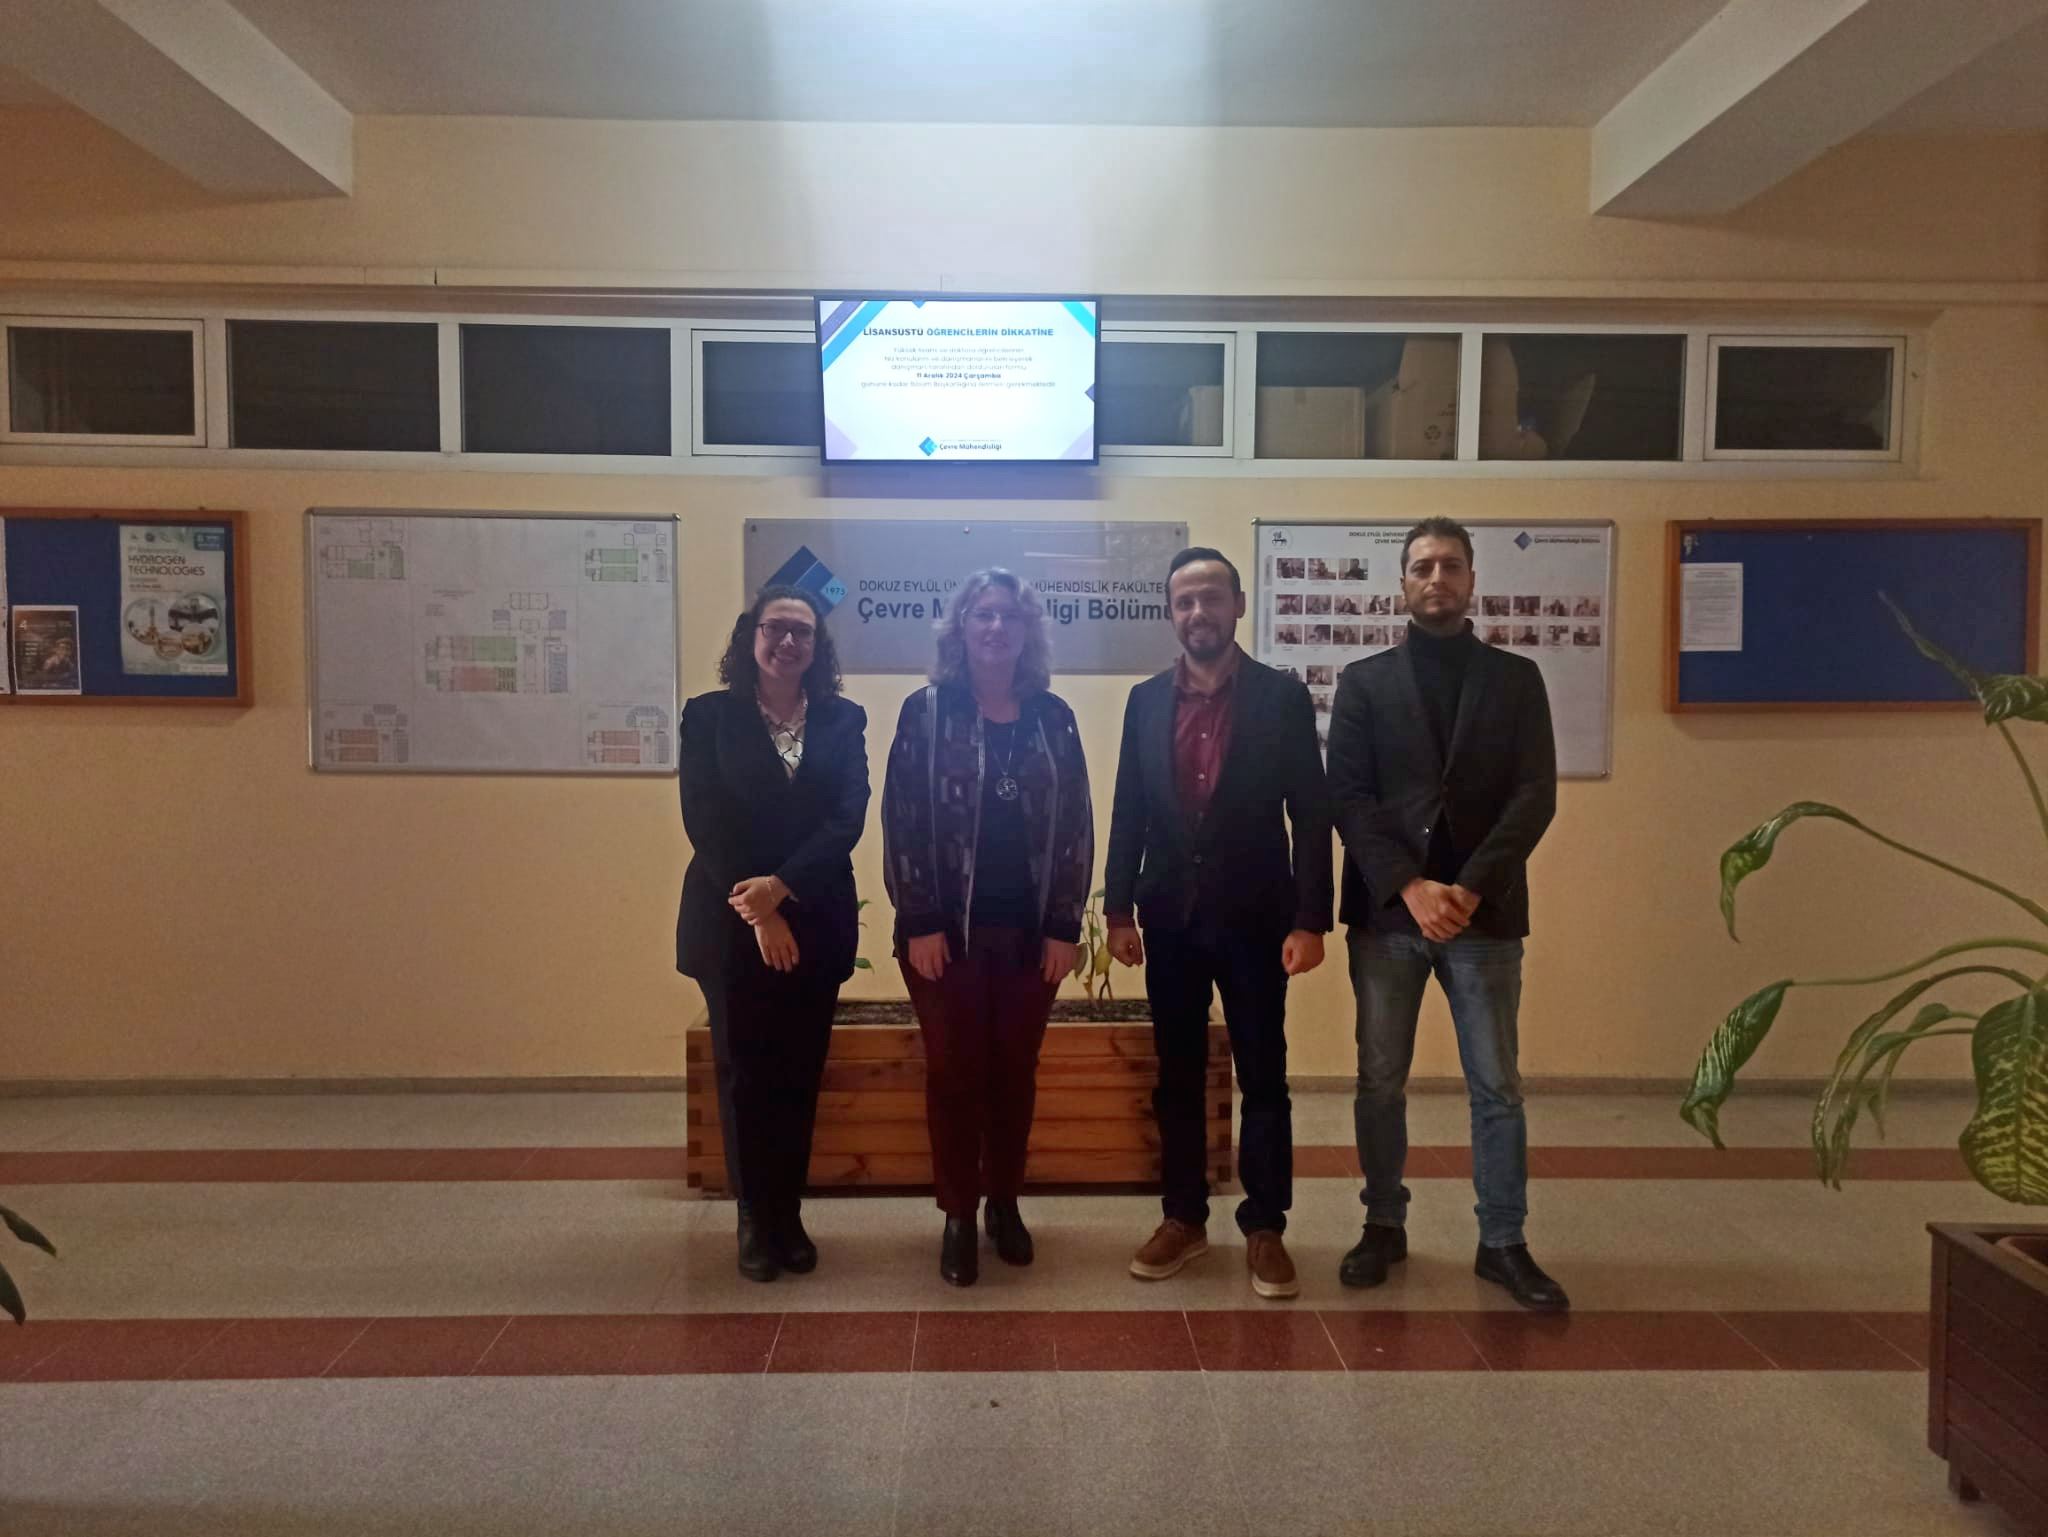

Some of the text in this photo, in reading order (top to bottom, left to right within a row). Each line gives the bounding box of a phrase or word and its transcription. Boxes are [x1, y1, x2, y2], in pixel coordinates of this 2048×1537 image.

[1001, 327, 1054, 336] DİKKATİNE
[128, 554, 186, 565] HYDROGEN
[128, 565, 205, 576] TECHNOLOGIES
[859, 579, 901, 592] DOKUZ
[903, 578, 941, 592] EYLÜL
[858, 597, 925, 625] Çevre
